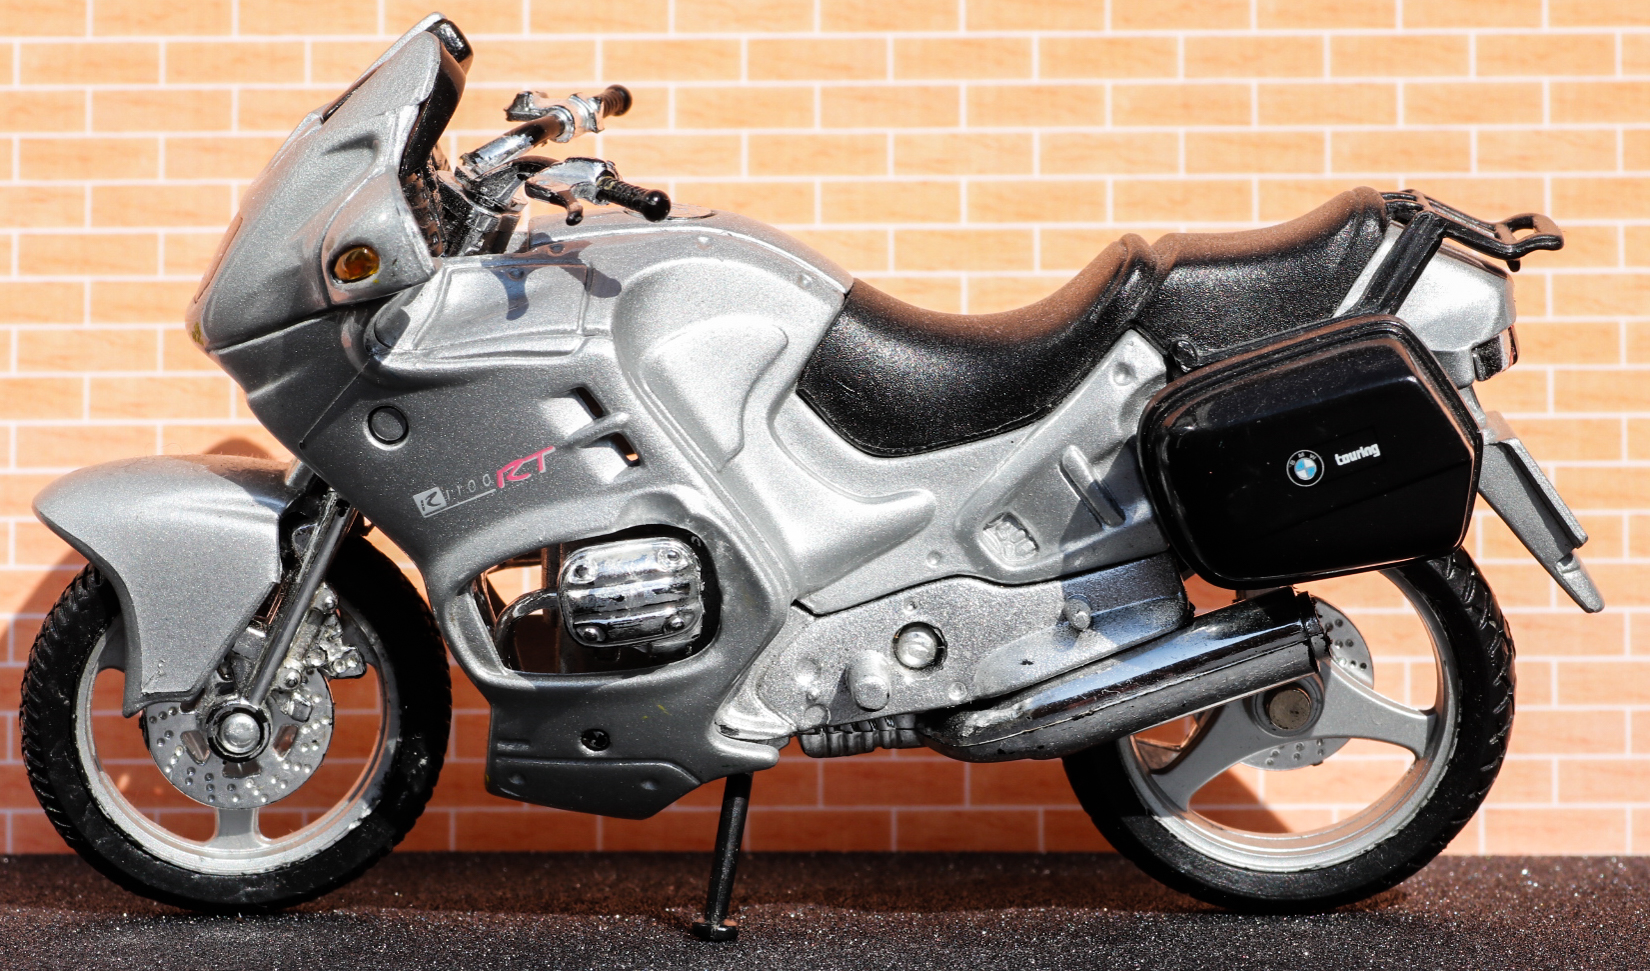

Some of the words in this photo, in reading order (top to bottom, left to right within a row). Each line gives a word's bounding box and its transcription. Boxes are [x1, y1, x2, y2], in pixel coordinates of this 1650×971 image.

[1289, 452, 1317, 467] BMW
[1335, 443, 1381, 466] touring
[496, 446, 556, 488] RT
